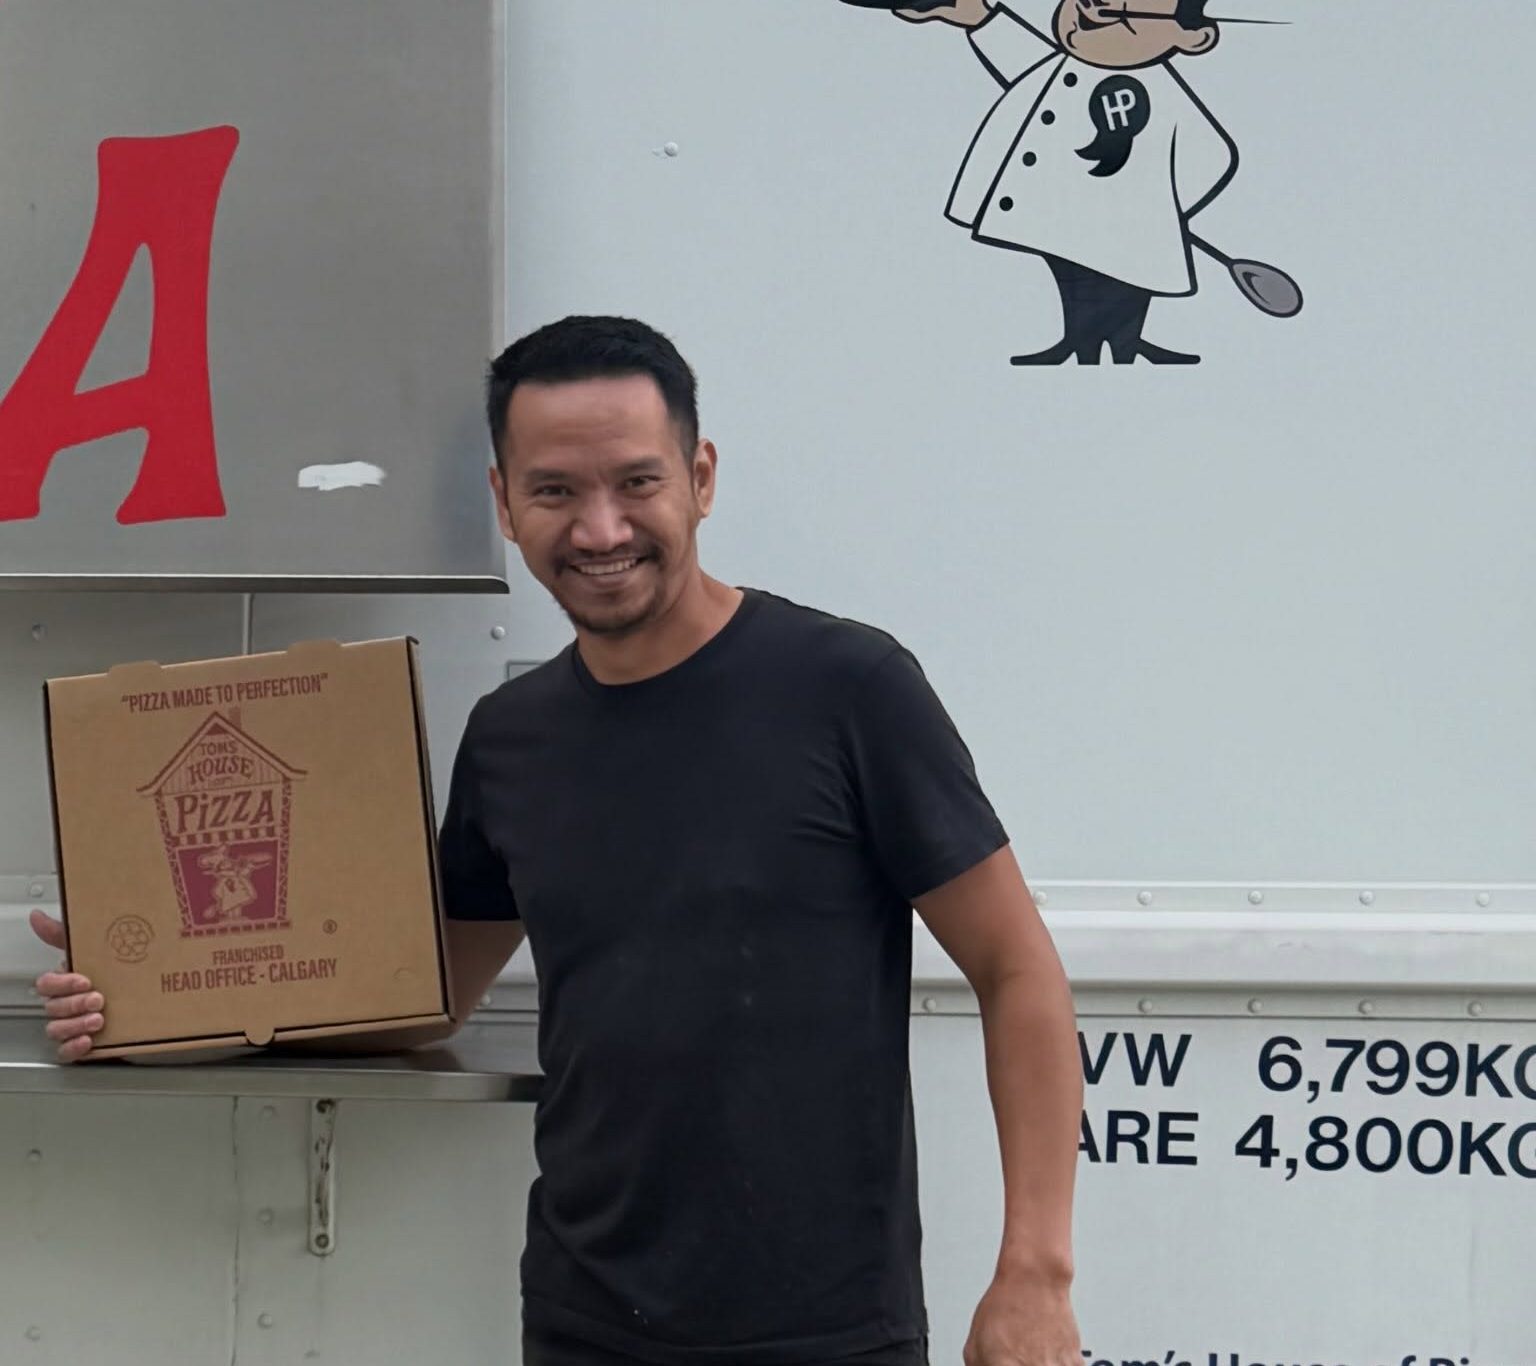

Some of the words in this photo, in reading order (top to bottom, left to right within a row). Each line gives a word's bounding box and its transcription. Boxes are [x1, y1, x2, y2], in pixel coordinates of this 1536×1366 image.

[1101, 88, 1136, 131] HP
[173, 686, 213, 708] MADE
[217, 684, 233, 704] TO
[188, 755, 254, 785] HOUSE
[212, 944, 284, 965] FRANCHISED
[161, 971, 201, 993] HEAD
[206, 965, 256, 989] OFFICE
[268, 958, 338, 984] CALGARY
[1076, 1031, 1192, 1087] VW
[1077, 1109, 1199, 1165] ARE
